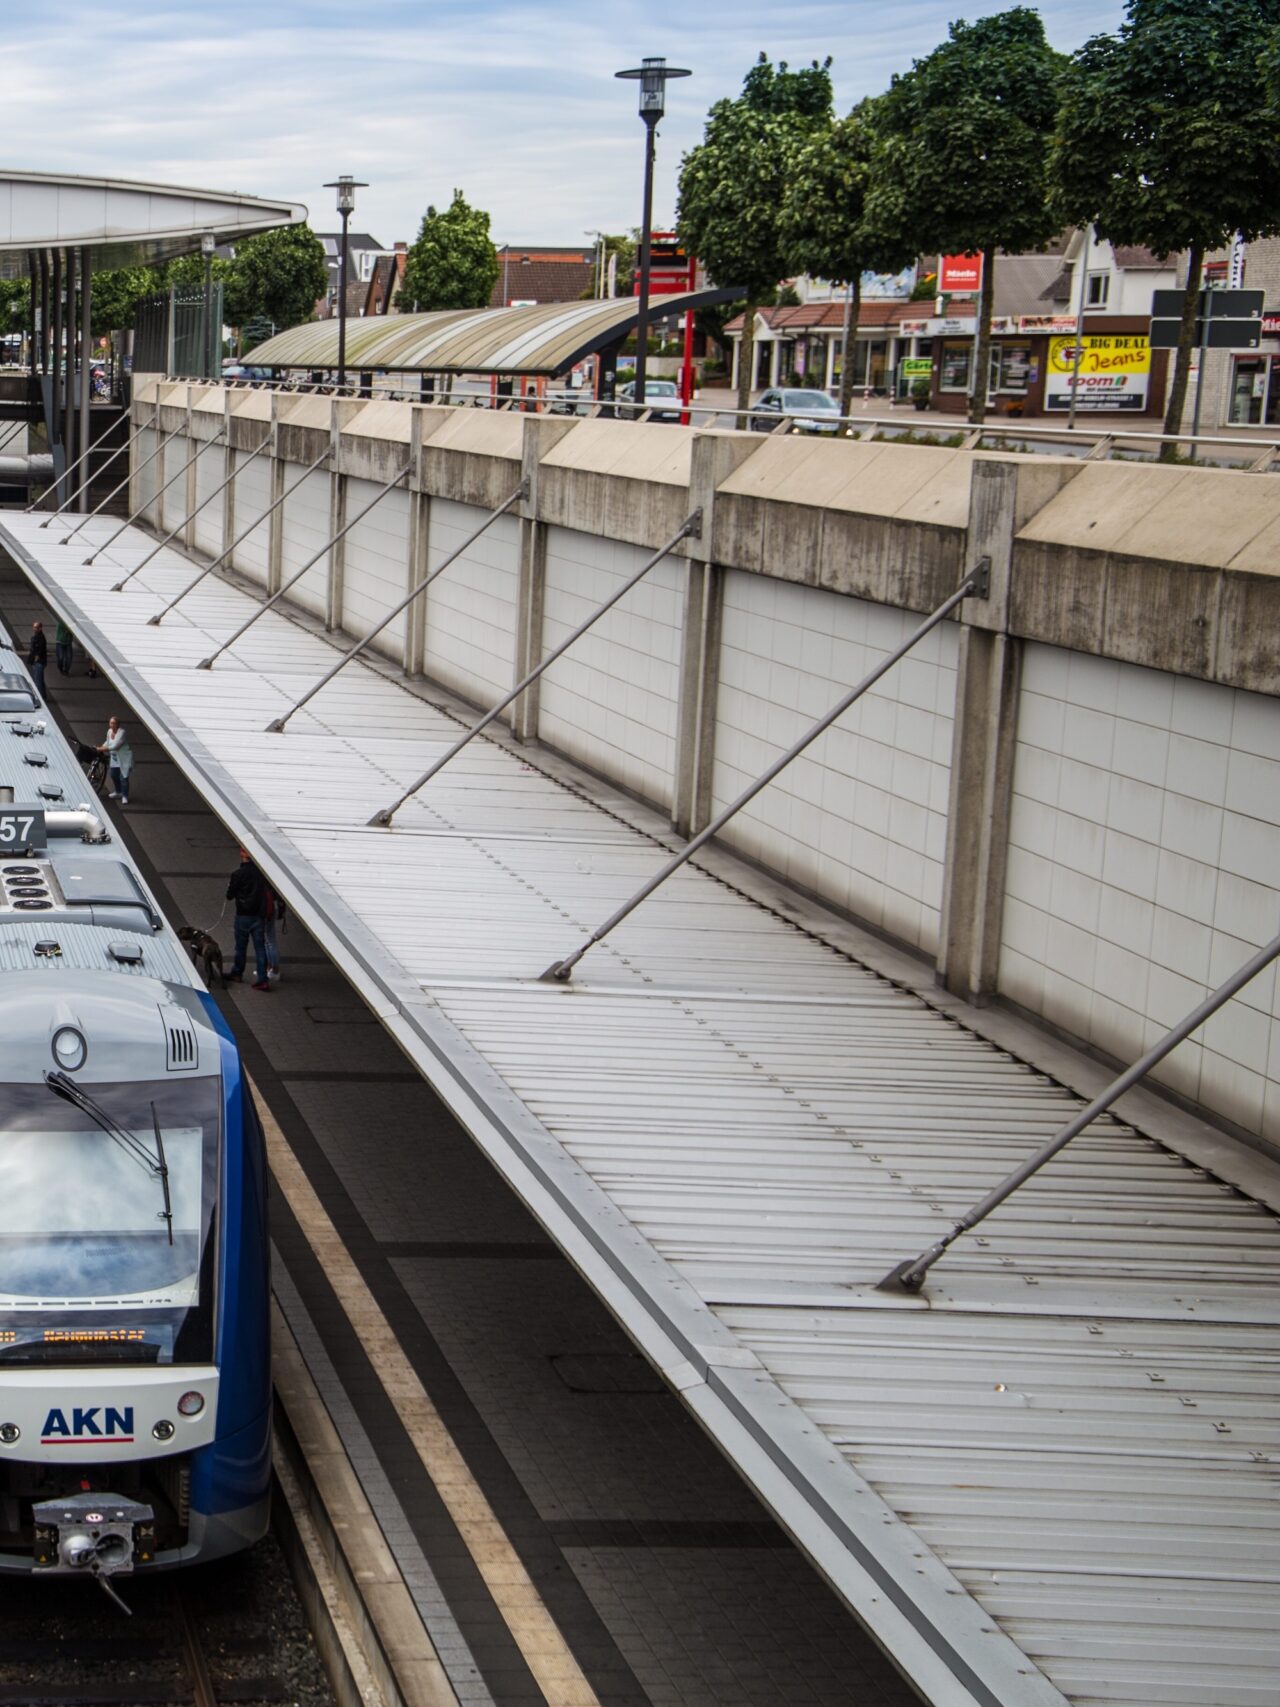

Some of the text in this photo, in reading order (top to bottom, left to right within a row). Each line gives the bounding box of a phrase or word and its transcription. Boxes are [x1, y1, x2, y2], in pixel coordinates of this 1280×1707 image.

[1090, 338, 1148, 349] BIG DEAL
[1088, 350, 1147, 372] Jeans
[40, 1407, 134, 1437] AKN
